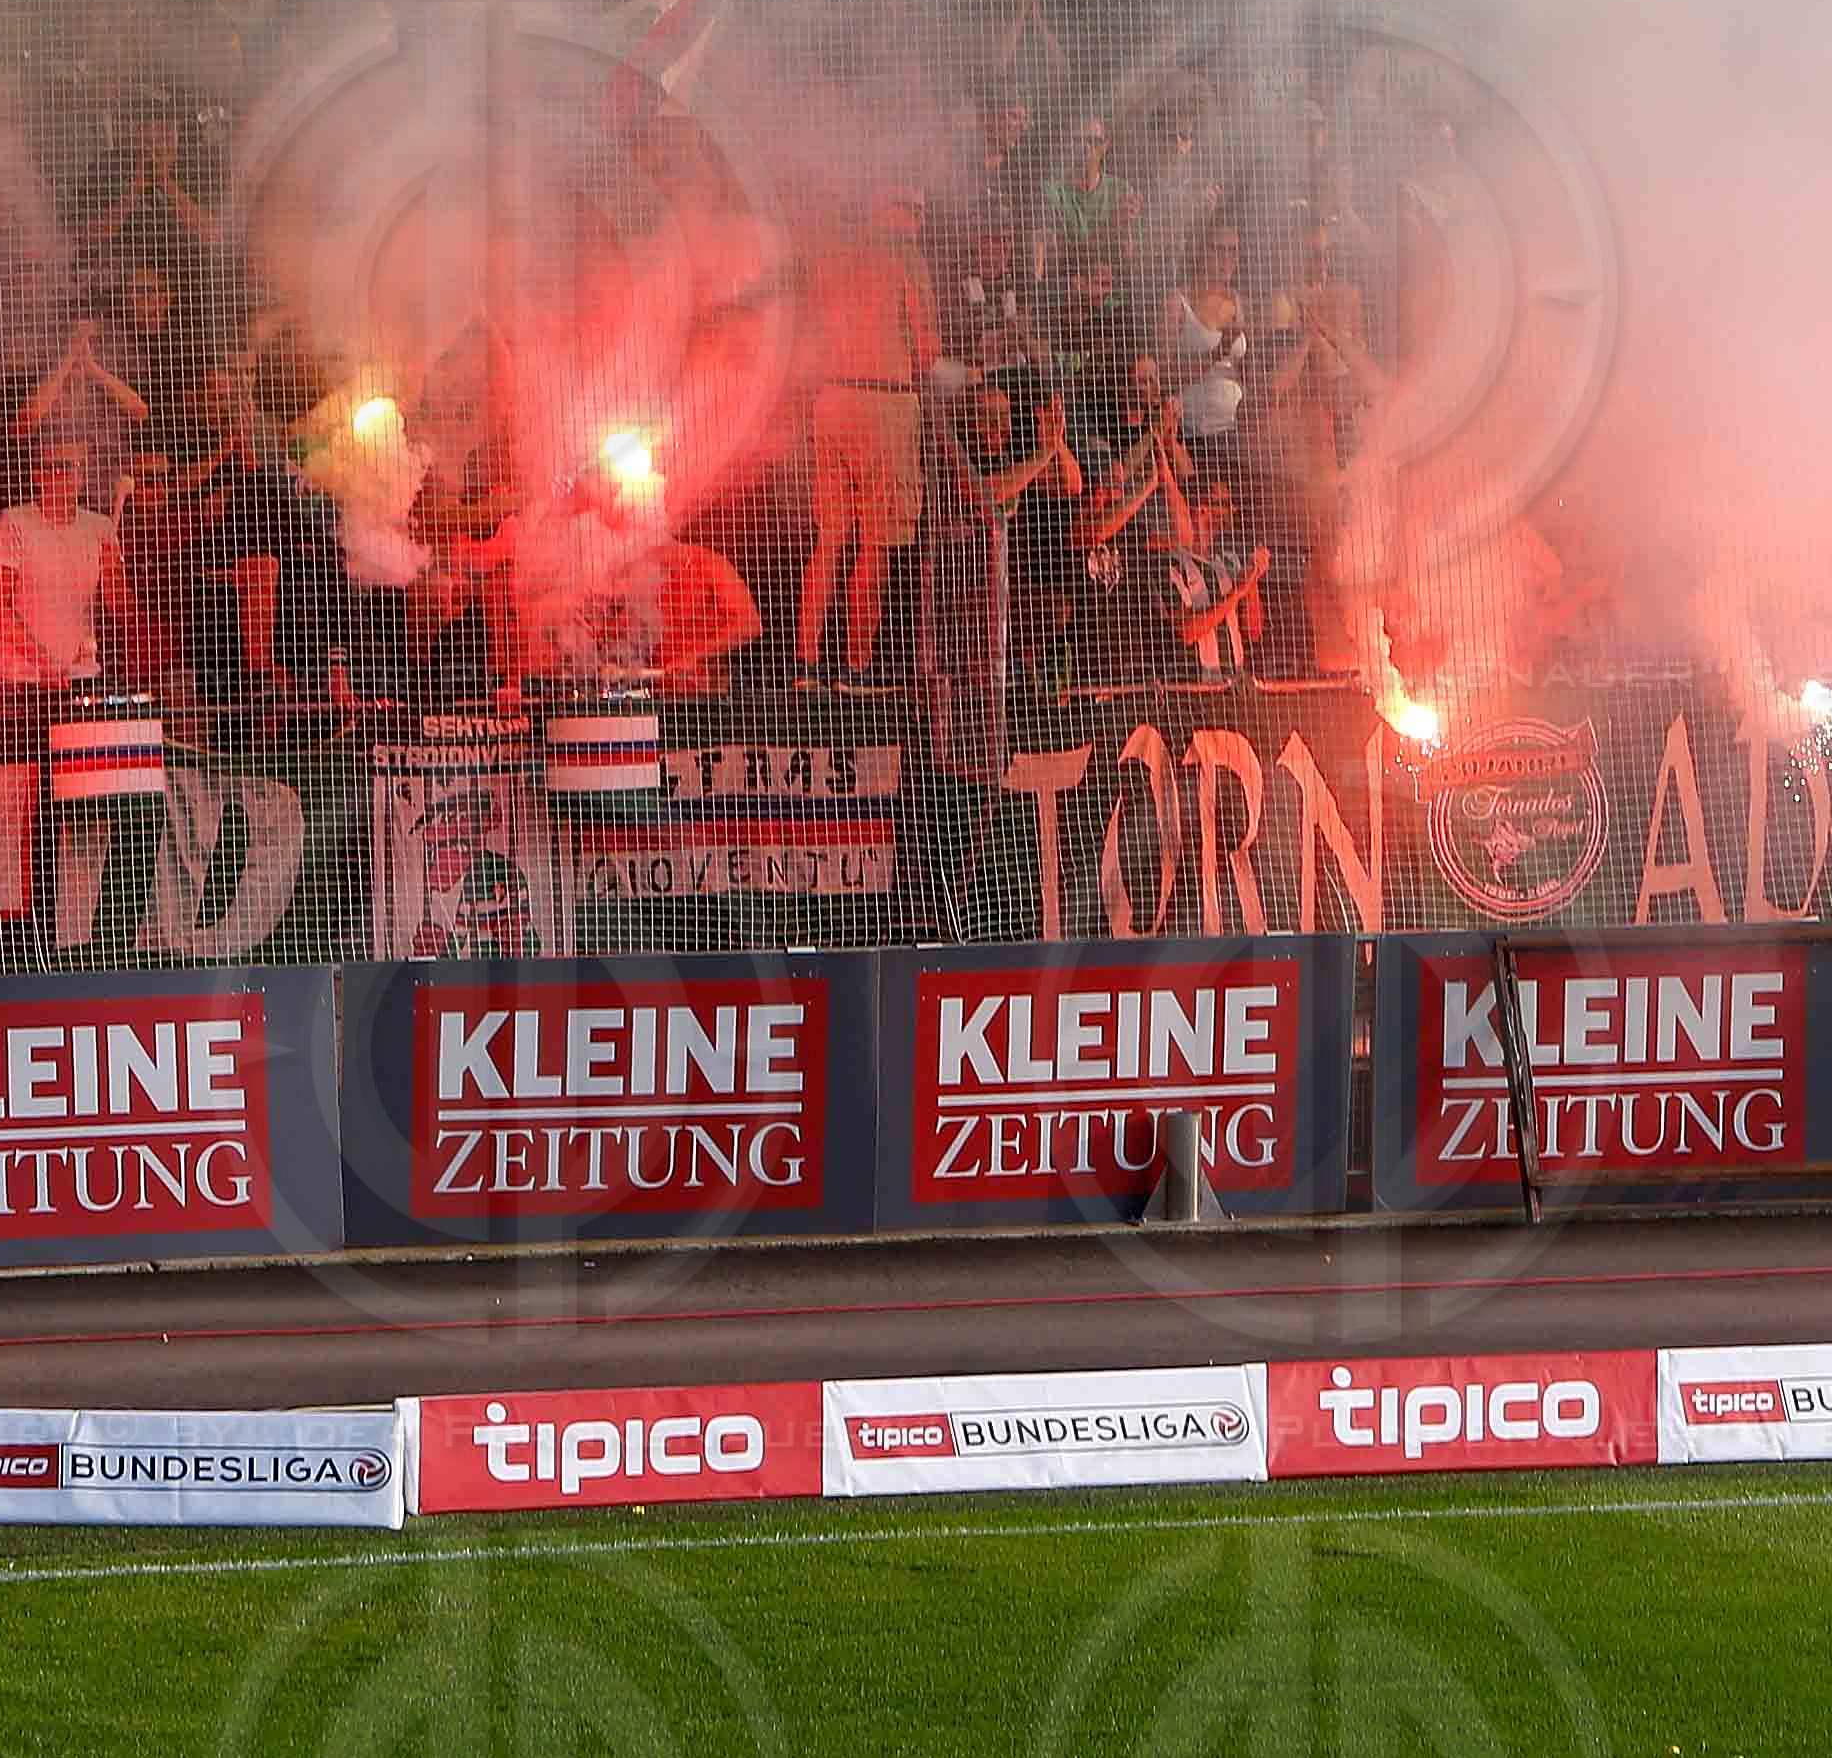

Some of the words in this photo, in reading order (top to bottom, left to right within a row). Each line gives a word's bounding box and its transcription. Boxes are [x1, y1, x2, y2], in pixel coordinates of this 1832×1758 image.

[437, 1002, 805, 1100] KLEINE
[937, 984, 1277, 1086] KLEINE
[1443, 972, 1784, 1068] KLEINE
[433, 1122, 807, 1195] ZEITUNG
[472, 1400, 765, 1495] tipico
[856, 1420, 945, 1454] tipico
[960, 1412, 1208, 1449] BUNDESLIGA
[1319, 1365, 1600, 1460] tipico
[1691, 1386, 1775, 1418] tipico
[70, 1452, 342, 1486] BUNDESLIGA
